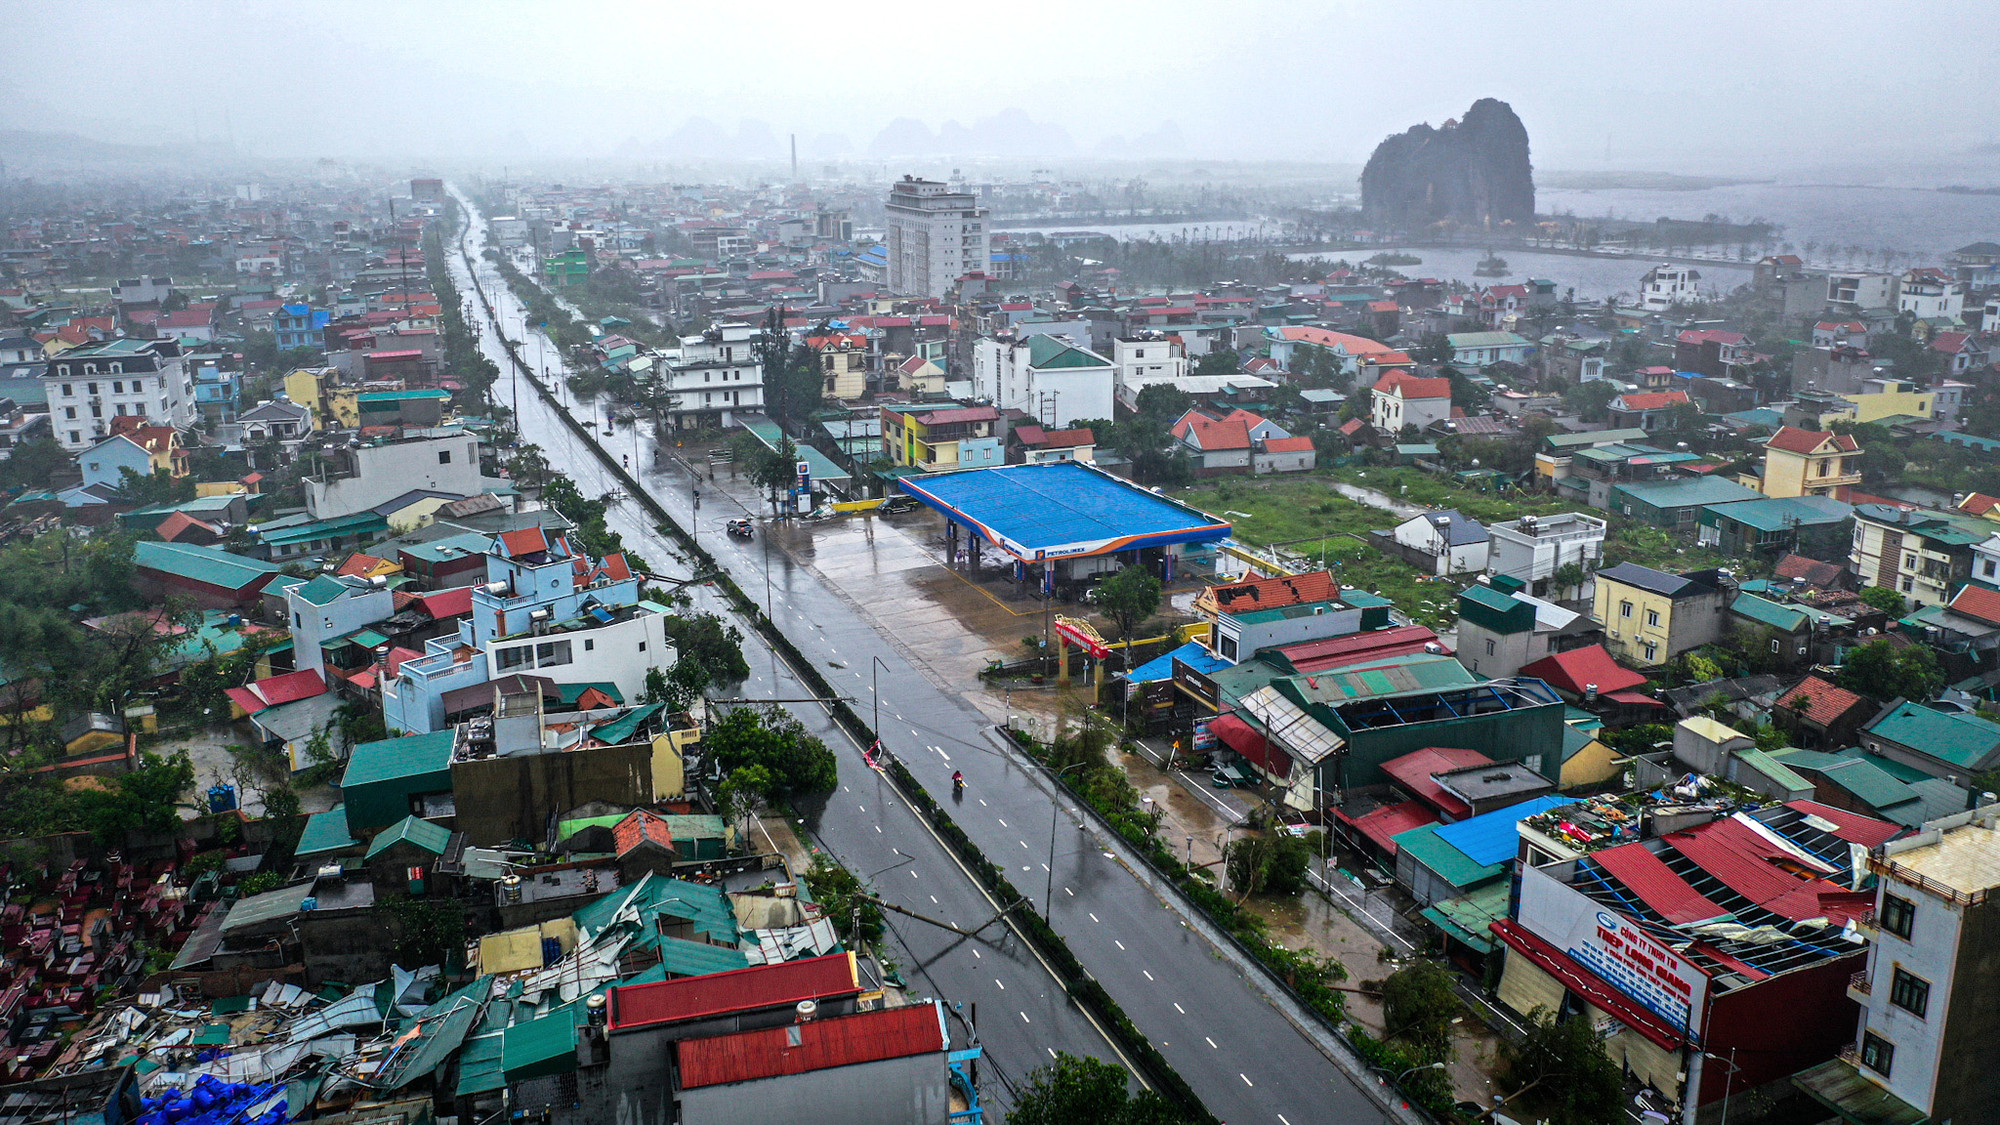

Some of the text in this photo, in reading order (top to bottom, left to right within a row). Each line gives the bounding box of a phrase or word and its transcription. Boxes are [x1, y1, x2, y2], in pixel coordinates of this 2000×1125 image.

[1047, 547, 1085, 555] PETROLIMEX
[1597, 925, 1624, 949] THÉP
[1625, 944, 1655, 972] LONG
[1656, 965, 1692, 996] GIANG
[1620, 926, 1638, 944] CÔNG
[1639, 938, 1647, 950] TY
[1648, 943, 1666, 962] TNHH
